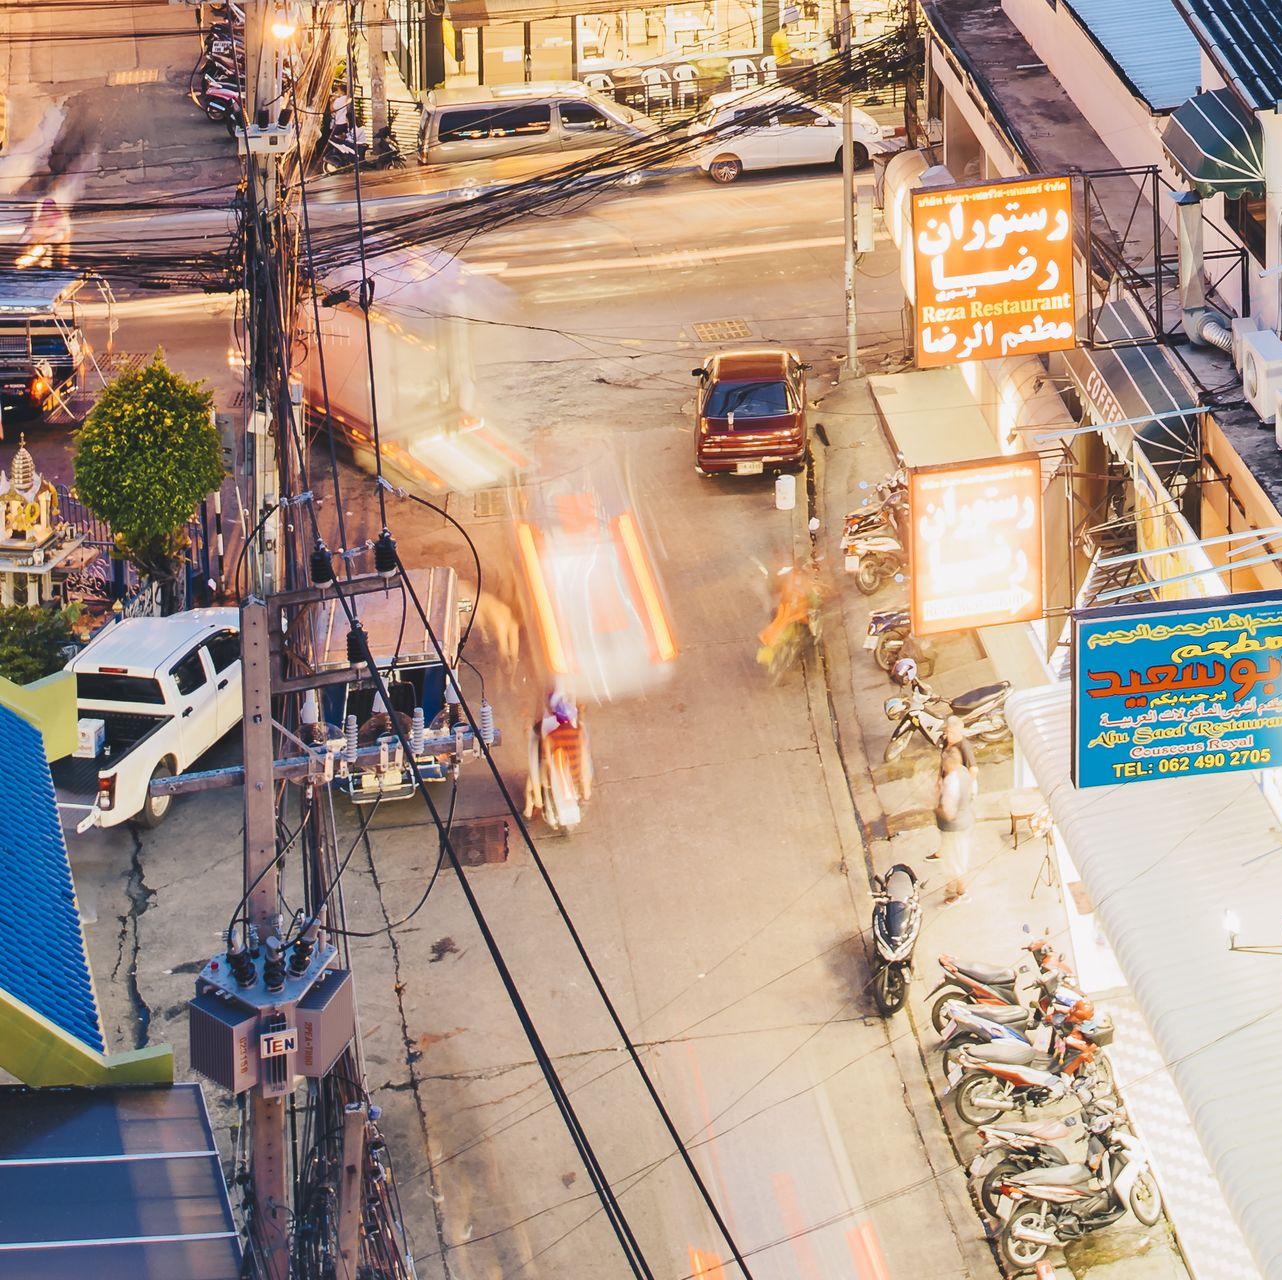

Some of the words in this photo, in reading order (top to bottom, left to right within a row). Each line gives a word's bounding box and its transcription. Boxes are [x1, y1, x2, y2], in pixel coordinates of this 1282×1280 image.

[917, 202, 1069, 256] رستوران
[921, 304, 967, 324] Reza
[970, 292, 1072, 318] Restaurant
[922, 320, 994, 358] الرضا
[1001, 314, 1073, 357] مطعم
[1086, 659, 1227, 709] سعيد
[1087, 730, 1130, 748] Abu
[1129, 741, 1205, 759] Couscous
[1206, 735, 1255, 751] Royal
[1112, 761, 1154, 778] TEL:
[1158, 756, 1190, 773] 062
[1193, 752, 1226, 770] 490
[1229, 747, 1272, 767] 2705
[263, 1036, 295, 1054] TEN
